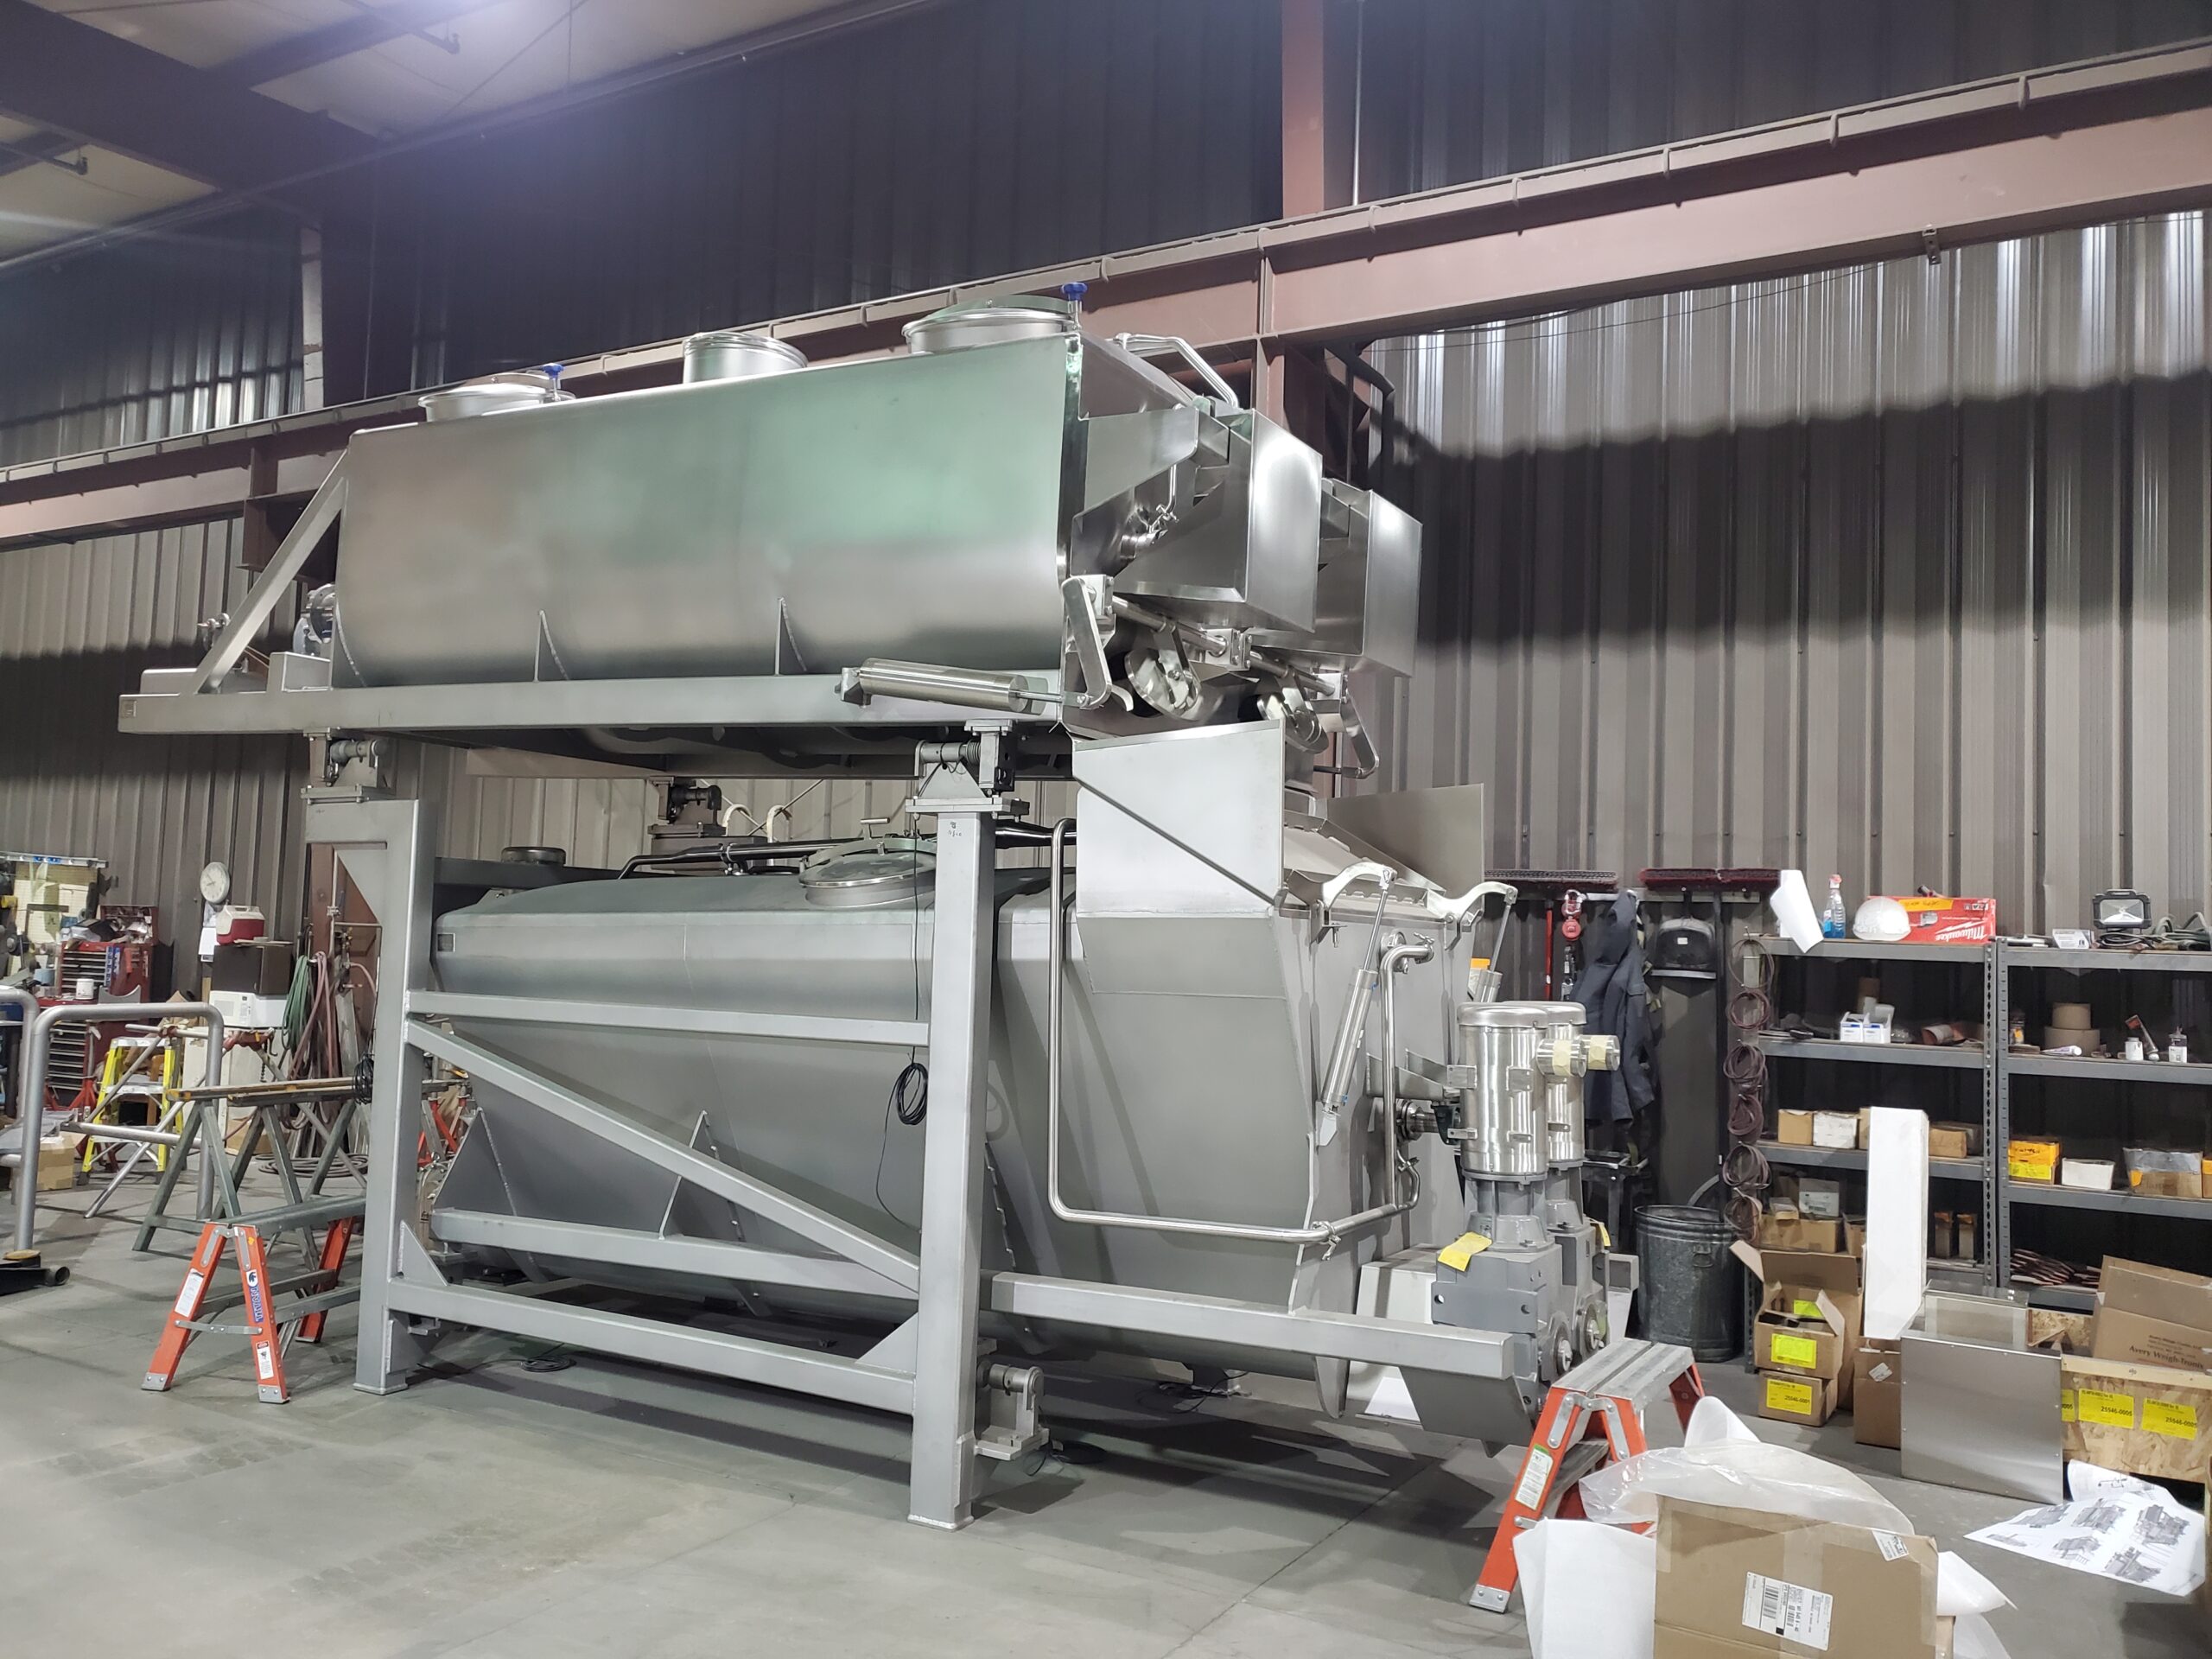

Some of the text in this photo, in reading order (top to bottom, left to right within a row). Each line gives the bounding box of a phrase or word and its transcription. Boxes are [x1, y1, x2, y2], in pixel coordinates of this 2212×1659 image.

[1936, 925, 1986, 942] Milwaukee
[251, 1287, 264, 1322] TITAN
[2129, 1344, 2151, 1357] Avery
